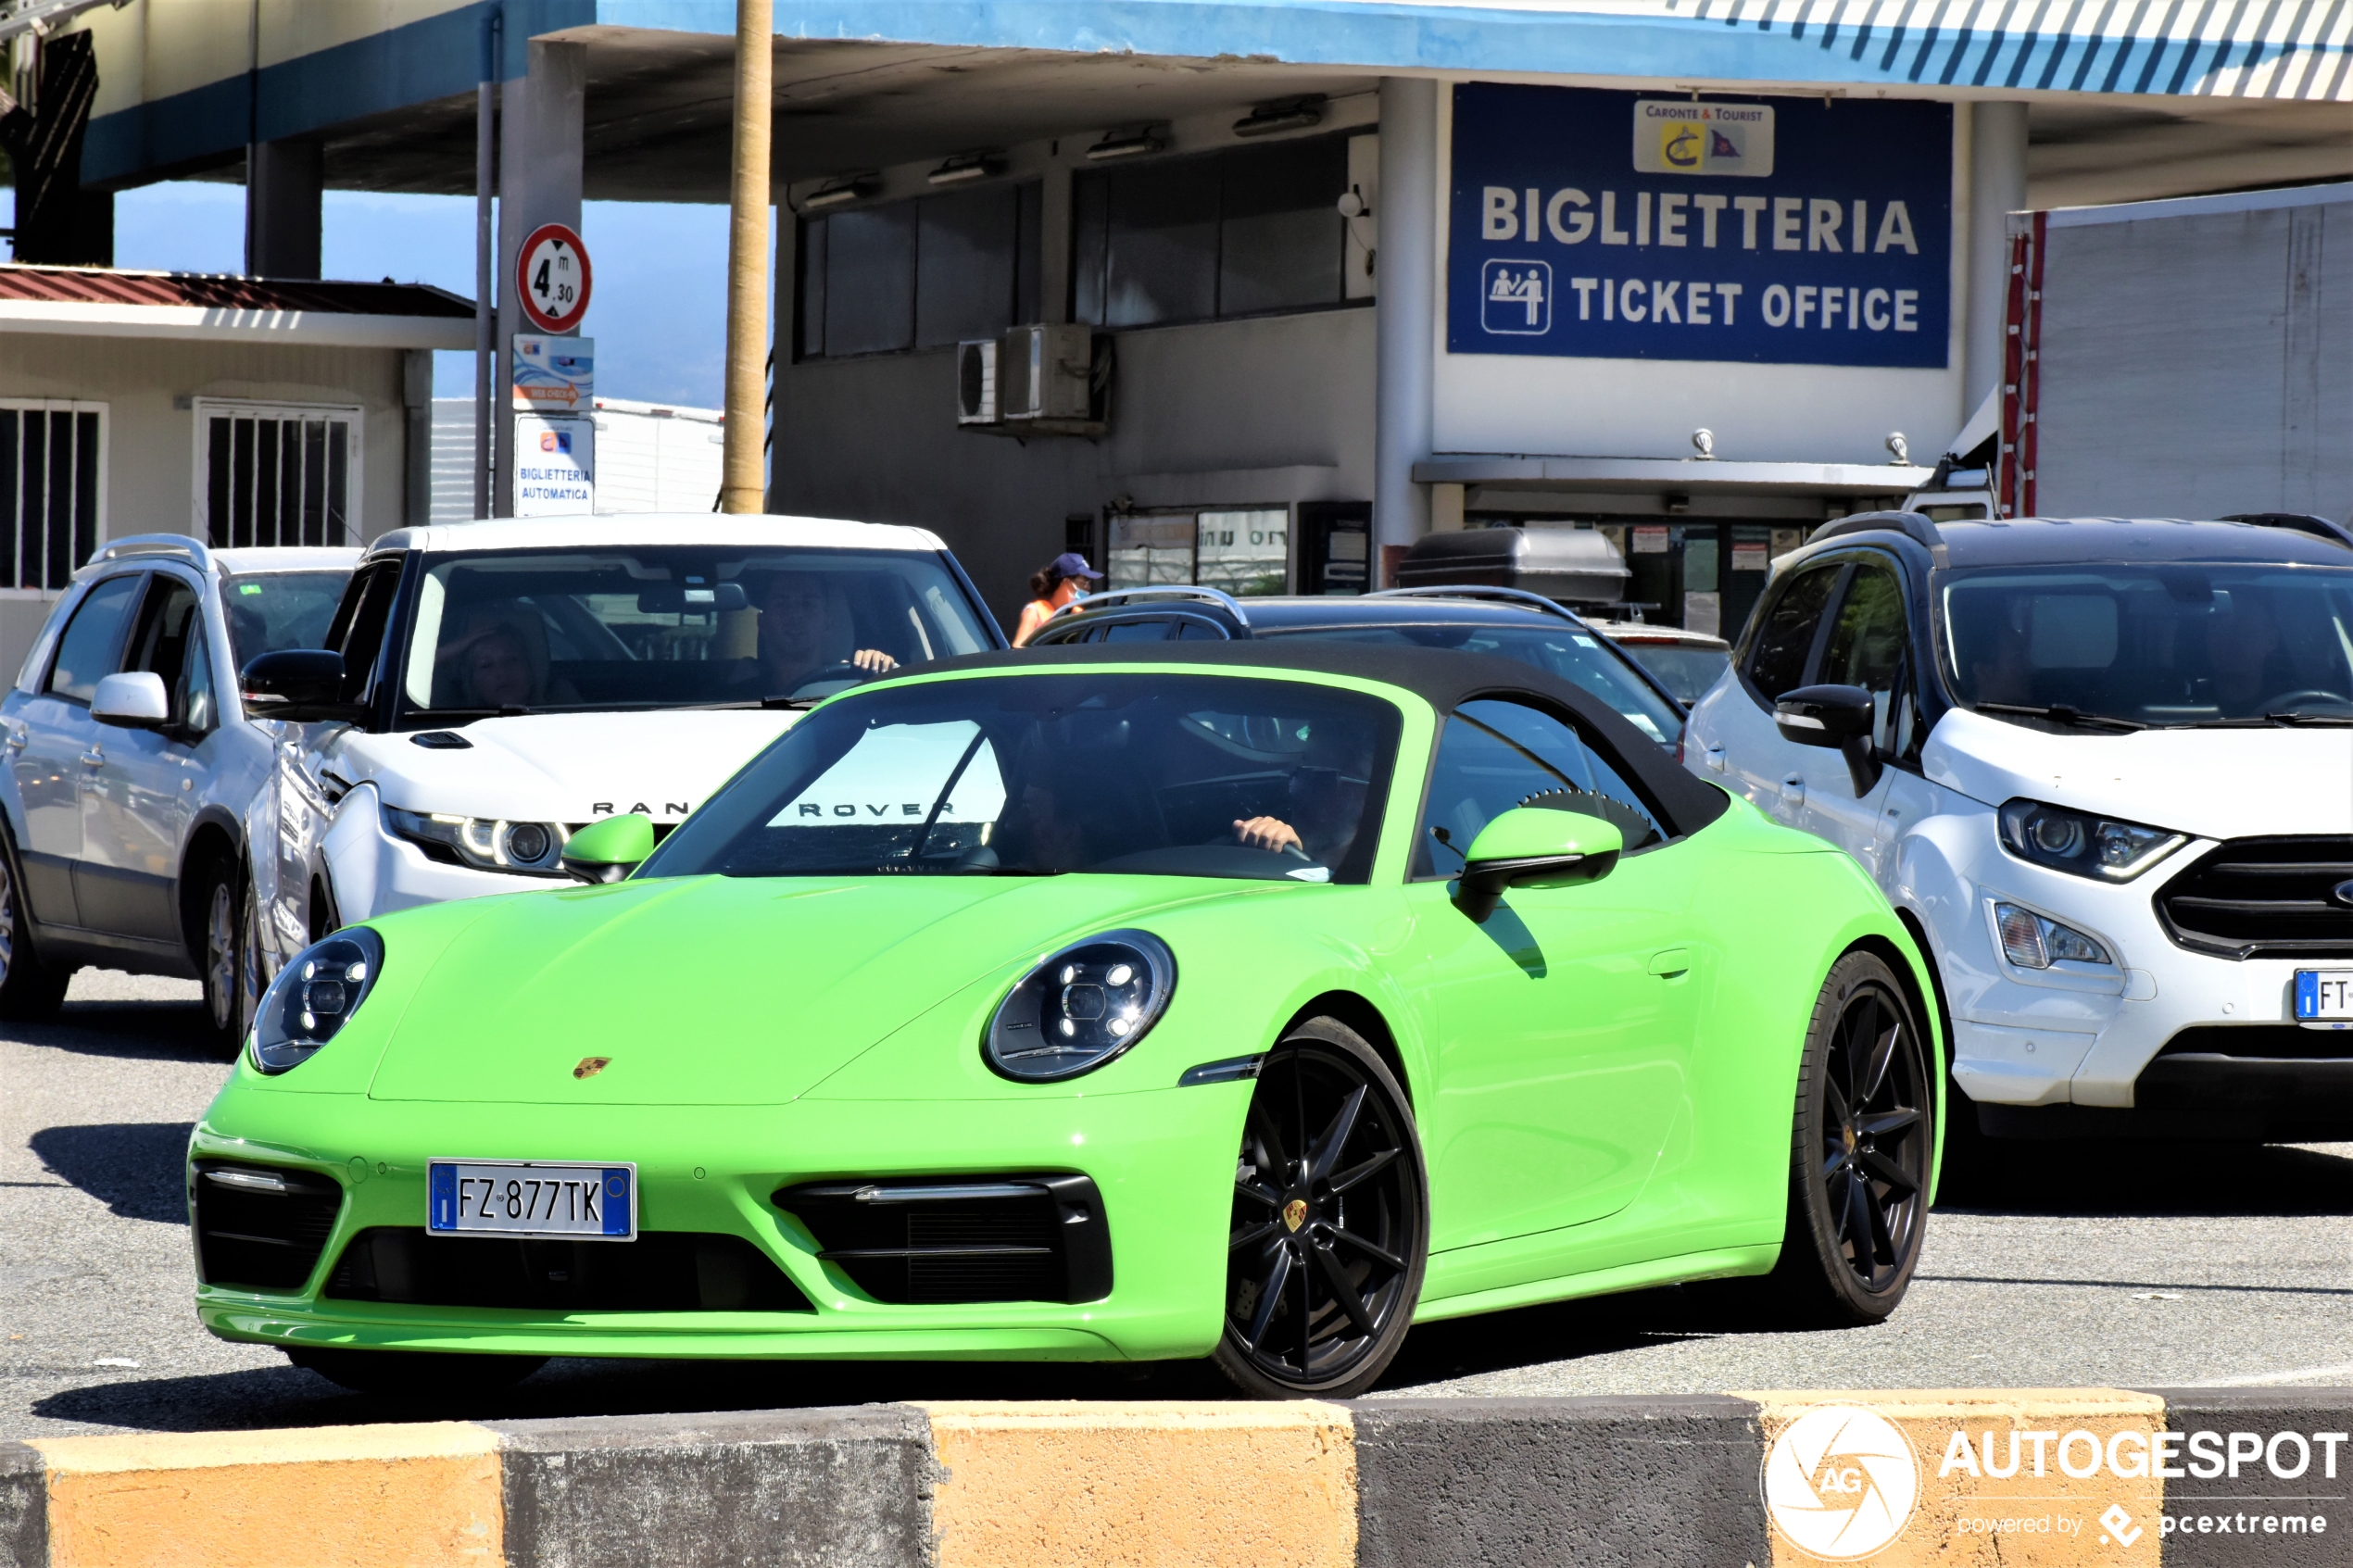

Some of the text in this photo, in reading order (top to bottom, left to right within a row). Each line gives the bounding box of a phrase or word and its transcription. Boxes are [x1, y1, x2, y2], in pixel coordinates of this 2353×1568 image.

[1701, 108, 1711, 119] &
[1483, 186, 1919, 255] BIGLIETTERIA
[1571, 277, 1919, 332] TICKET OFFICE
[532, 388, 546, 397] WEB
[521, 468, 591, 482] BIGLIETTERIA
[522, 487, 588, 500] AUTOMATICA
[593, 802, 956, 818] RAN ROVER
